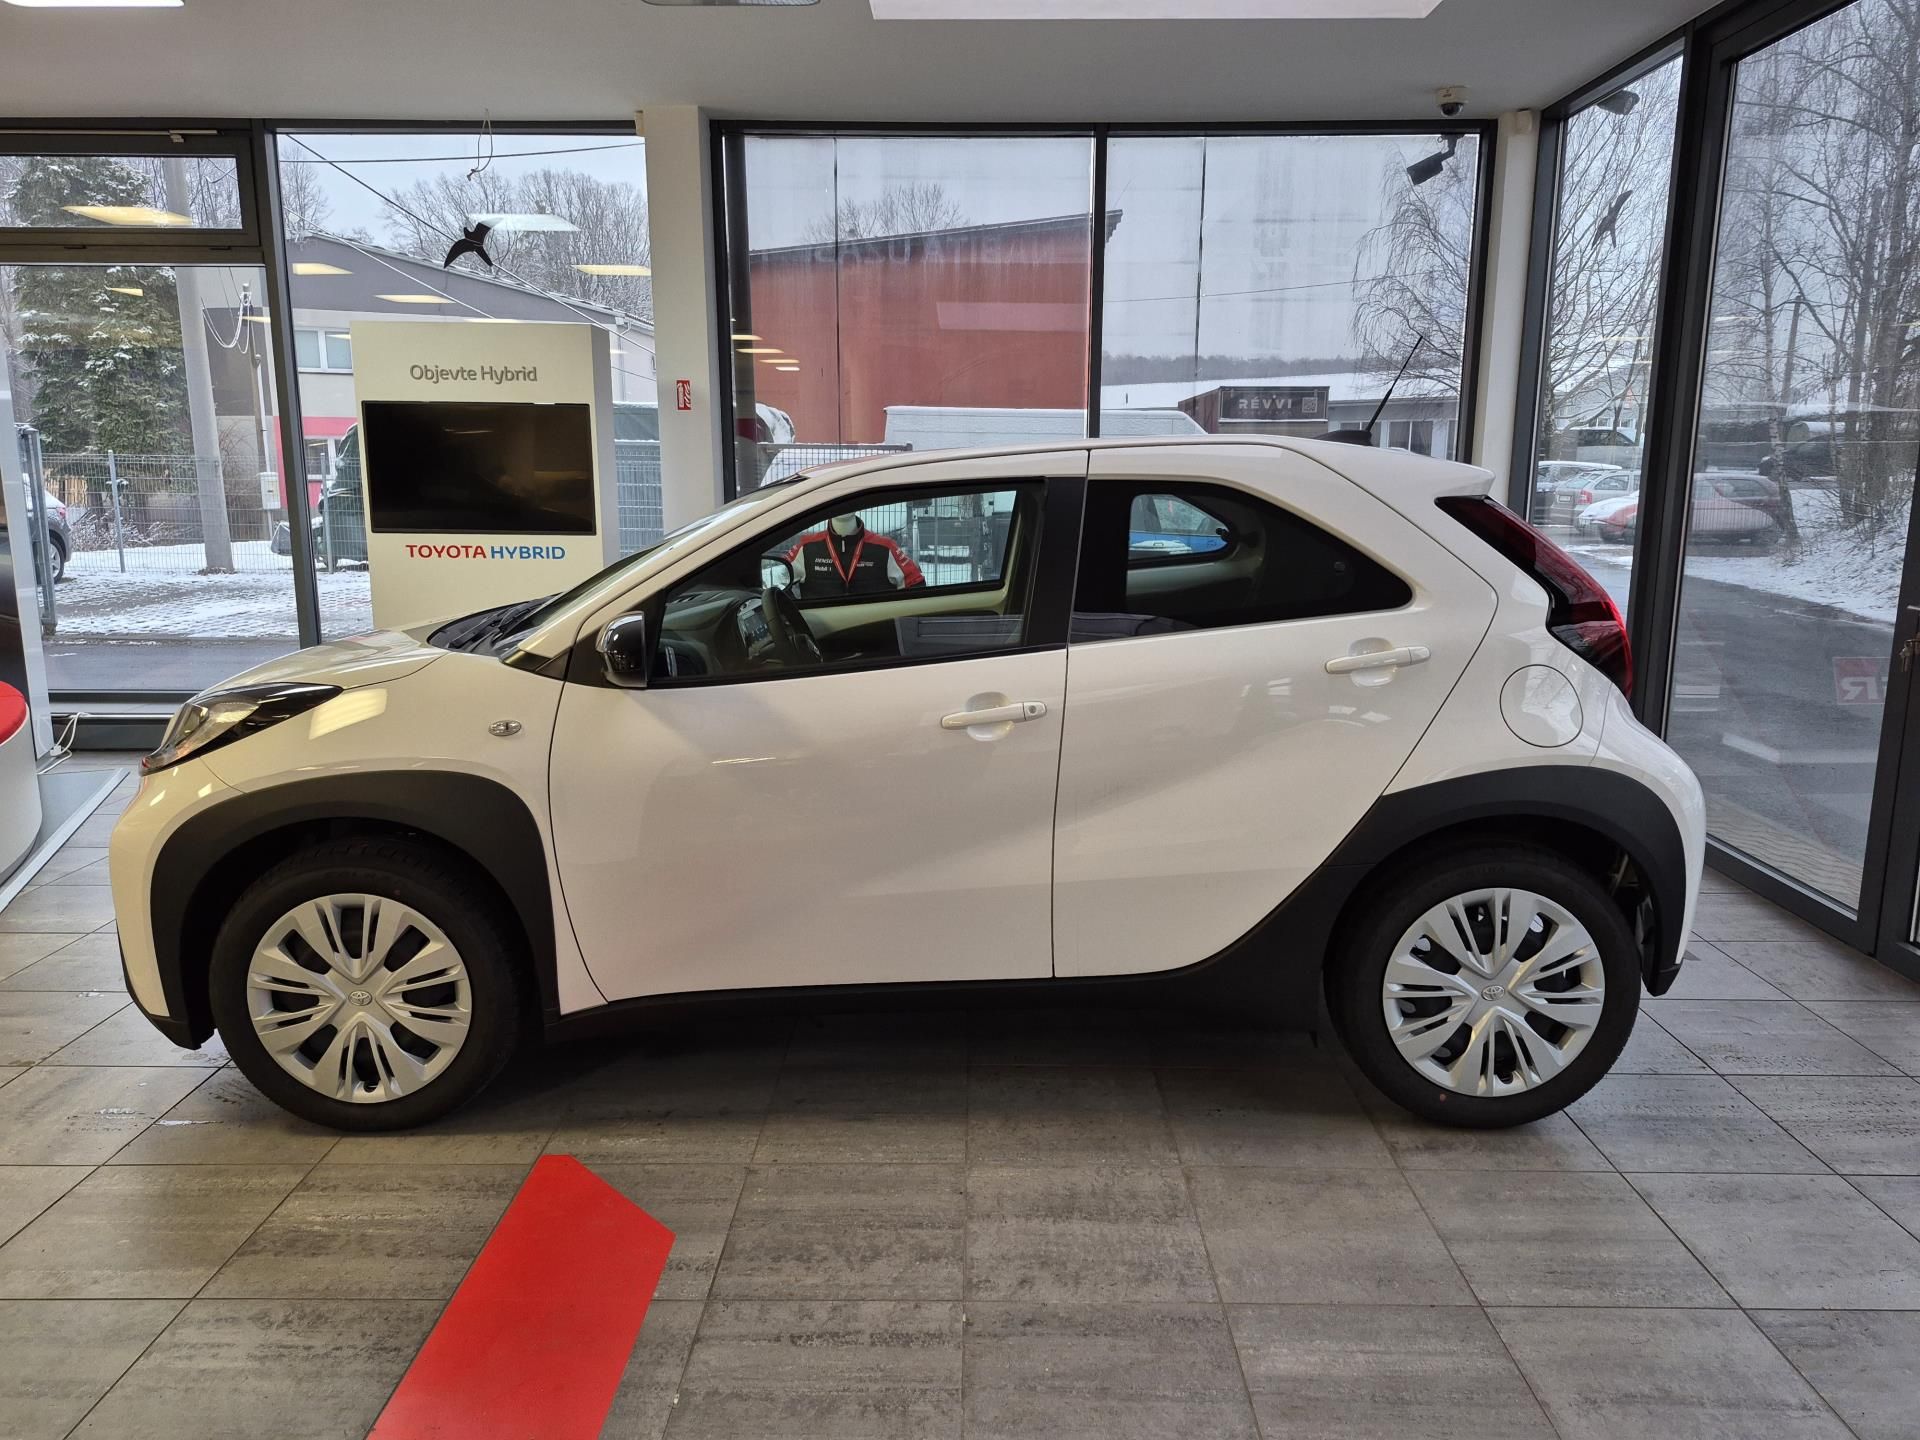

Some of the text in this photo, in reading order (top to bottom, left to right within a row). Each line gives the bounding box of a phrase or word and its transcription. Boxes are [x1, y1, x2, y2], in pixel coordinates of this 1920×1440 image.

[409, 364, 538, 385] Objevte Hybrid
[405, 544, 566, 560] TOYOTA HYBRID
